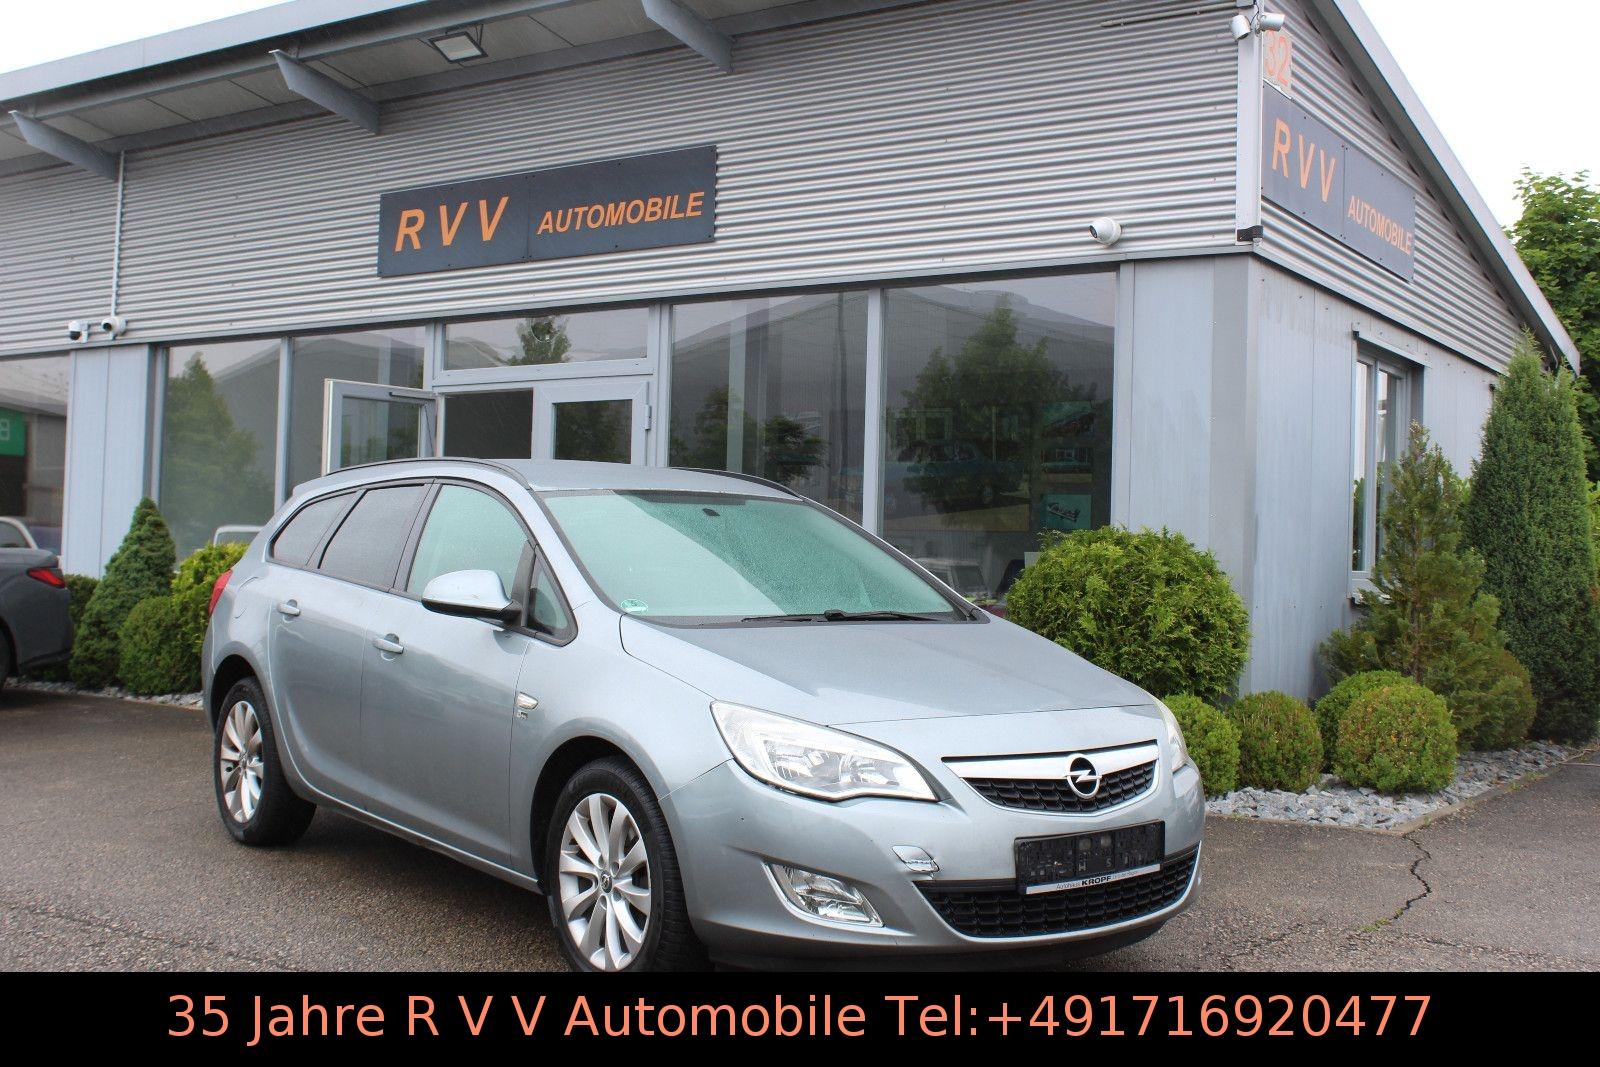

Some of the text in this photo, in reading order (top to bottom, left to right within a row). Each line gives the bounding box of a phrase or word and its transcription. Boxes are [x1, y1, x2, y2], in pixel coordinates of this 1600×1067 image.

[536, 191, 705, 235] AUTOMOBILE
[1347, 195, 1413, 256] AUTOMOBILE
[1081, 875, 1112, 886] KROPF
